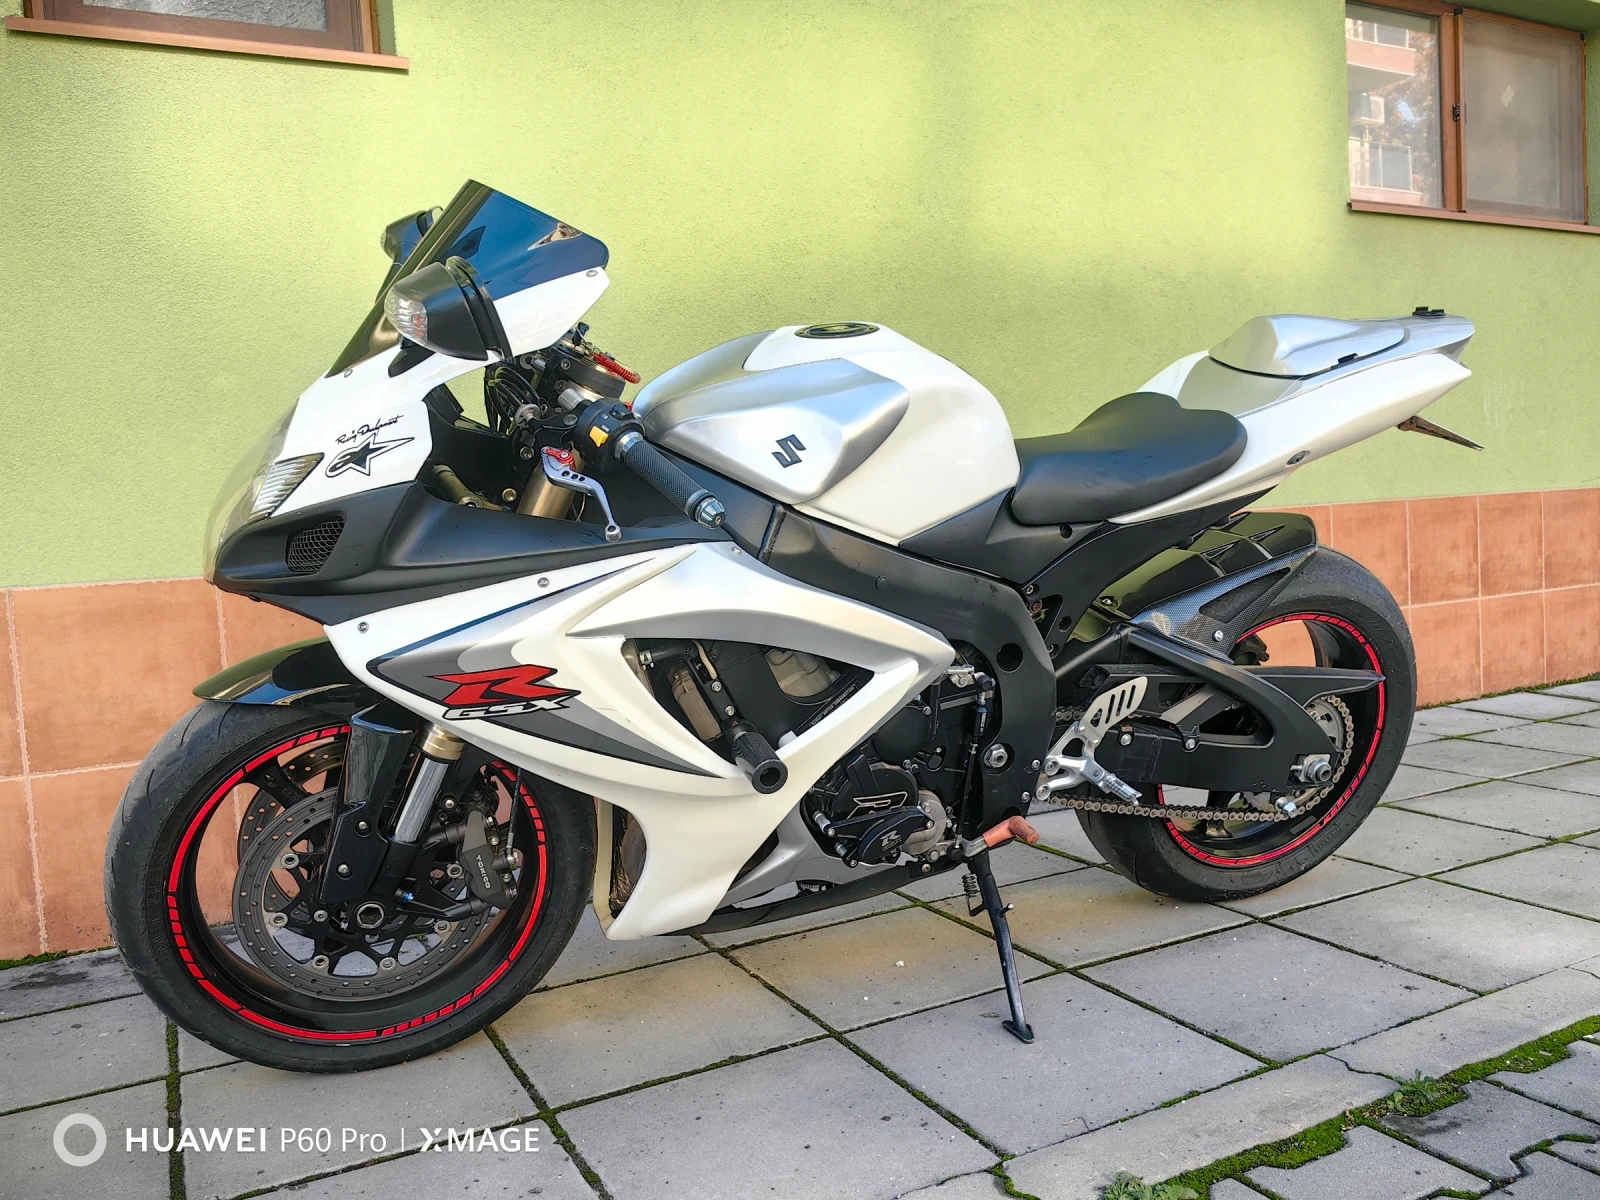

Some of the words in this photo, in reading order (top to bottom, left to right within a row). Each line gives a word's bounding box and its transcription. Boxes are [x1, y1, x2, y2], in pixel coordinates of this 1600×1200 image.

[424, 664, 582, 708] R
[442, 695, 572, 720] GSX
[475, 854, 491, 889] TOKICO
